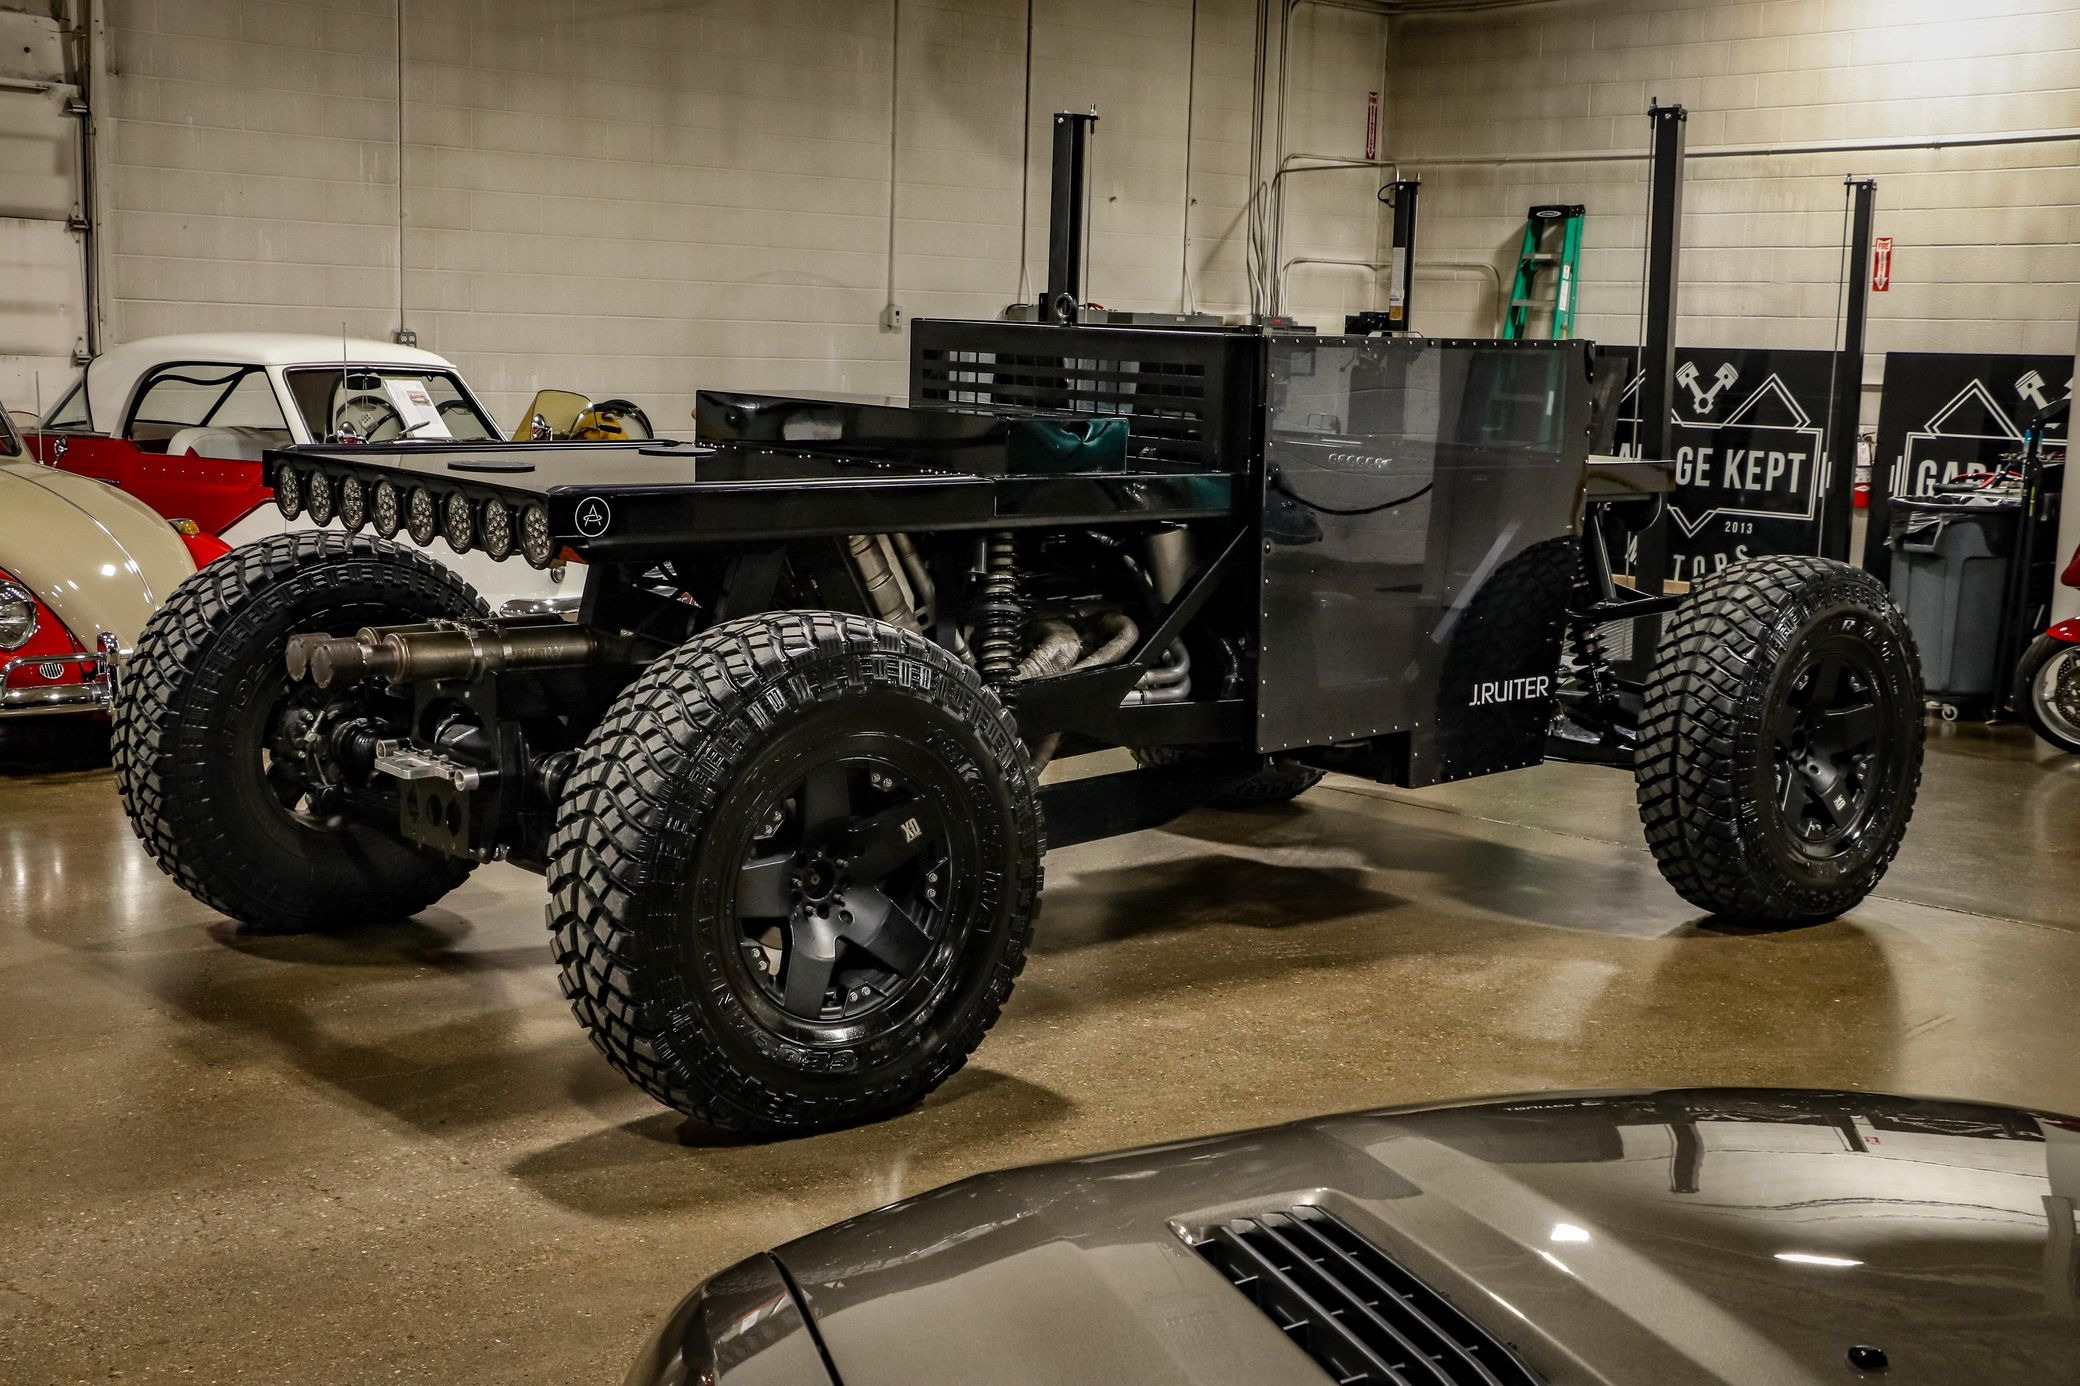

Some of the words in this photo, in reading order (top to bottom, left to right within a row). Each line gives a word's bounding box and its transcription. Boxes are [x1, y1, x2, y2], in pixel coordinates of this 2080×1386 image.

[1723, 449, 1807, 493] KEPT
[1724, 521, 1753, 534] 2013
[1468, 675, 1549, 706] J.RUITER
